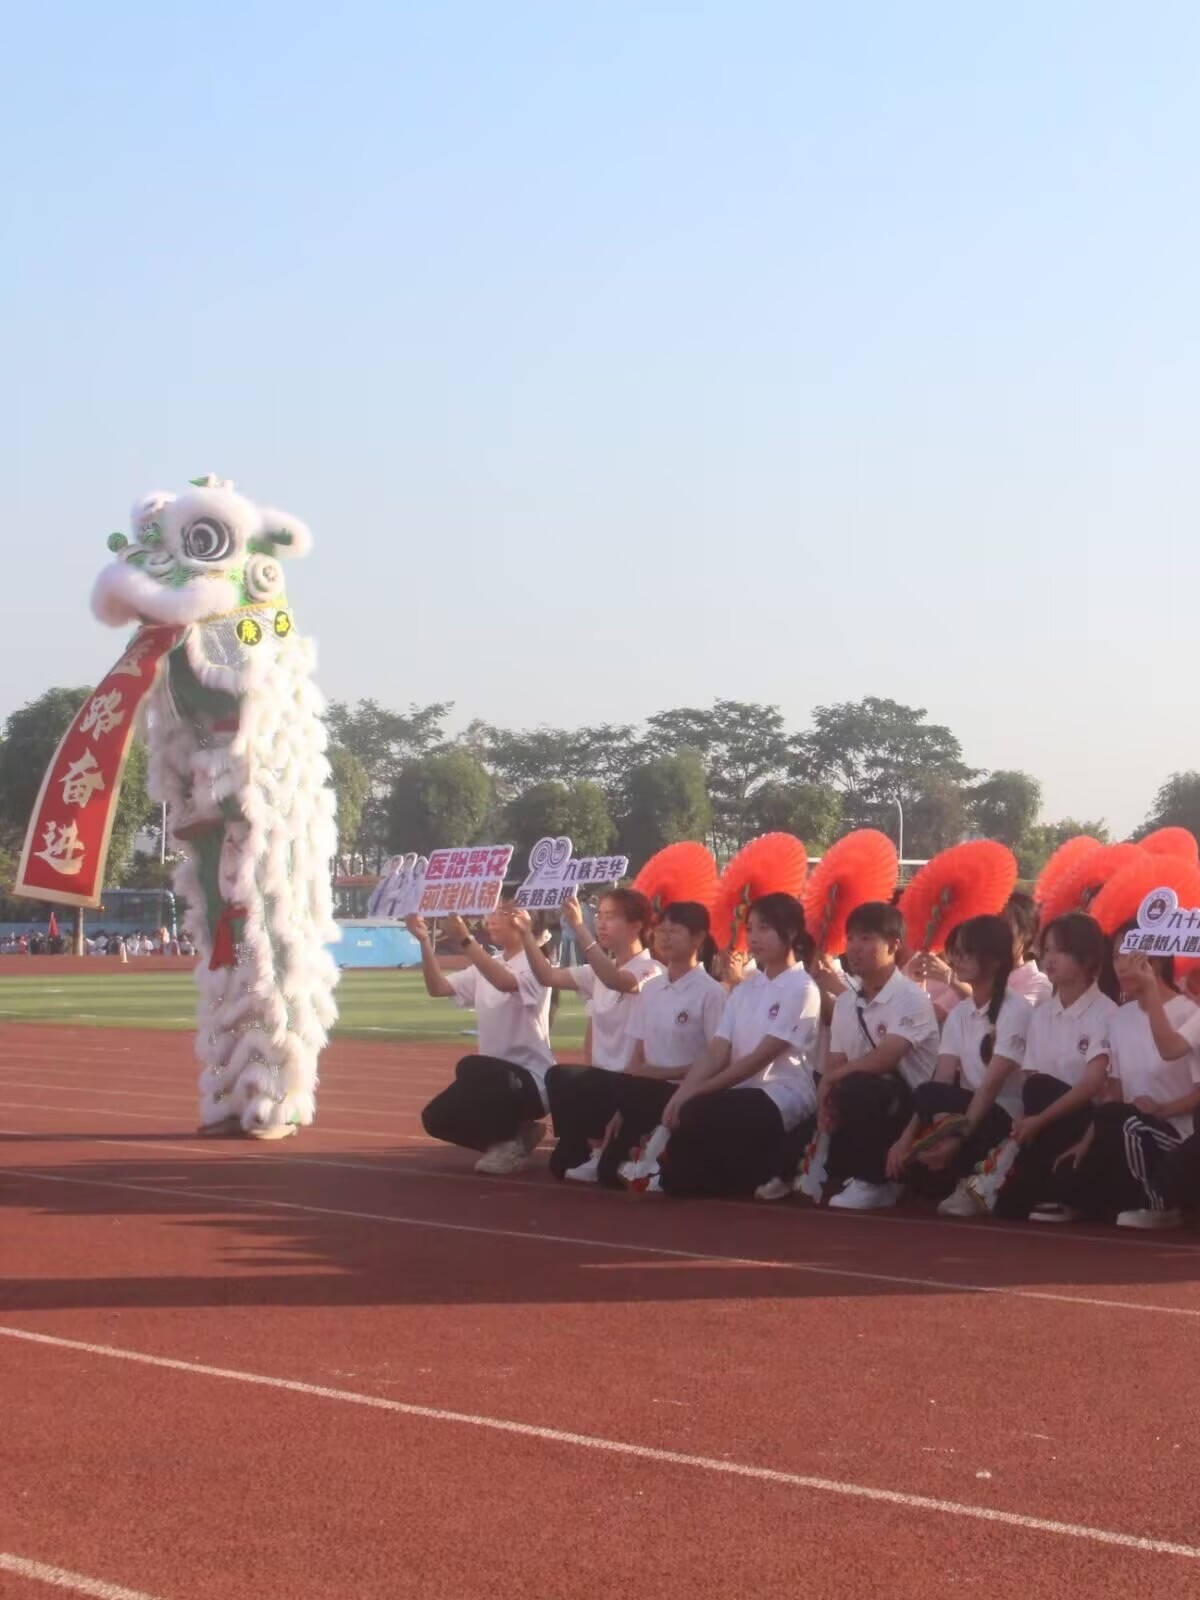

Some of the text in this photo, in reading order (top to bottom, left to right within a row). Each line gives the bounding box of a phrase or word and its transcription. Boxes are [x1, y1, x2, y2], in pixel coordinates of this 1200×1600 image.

[425, 848, 511, 880] 医路繁花
[563, 860, 623, 880] 九秩芳华
[419, 880, 500, 911] 前程似锦
